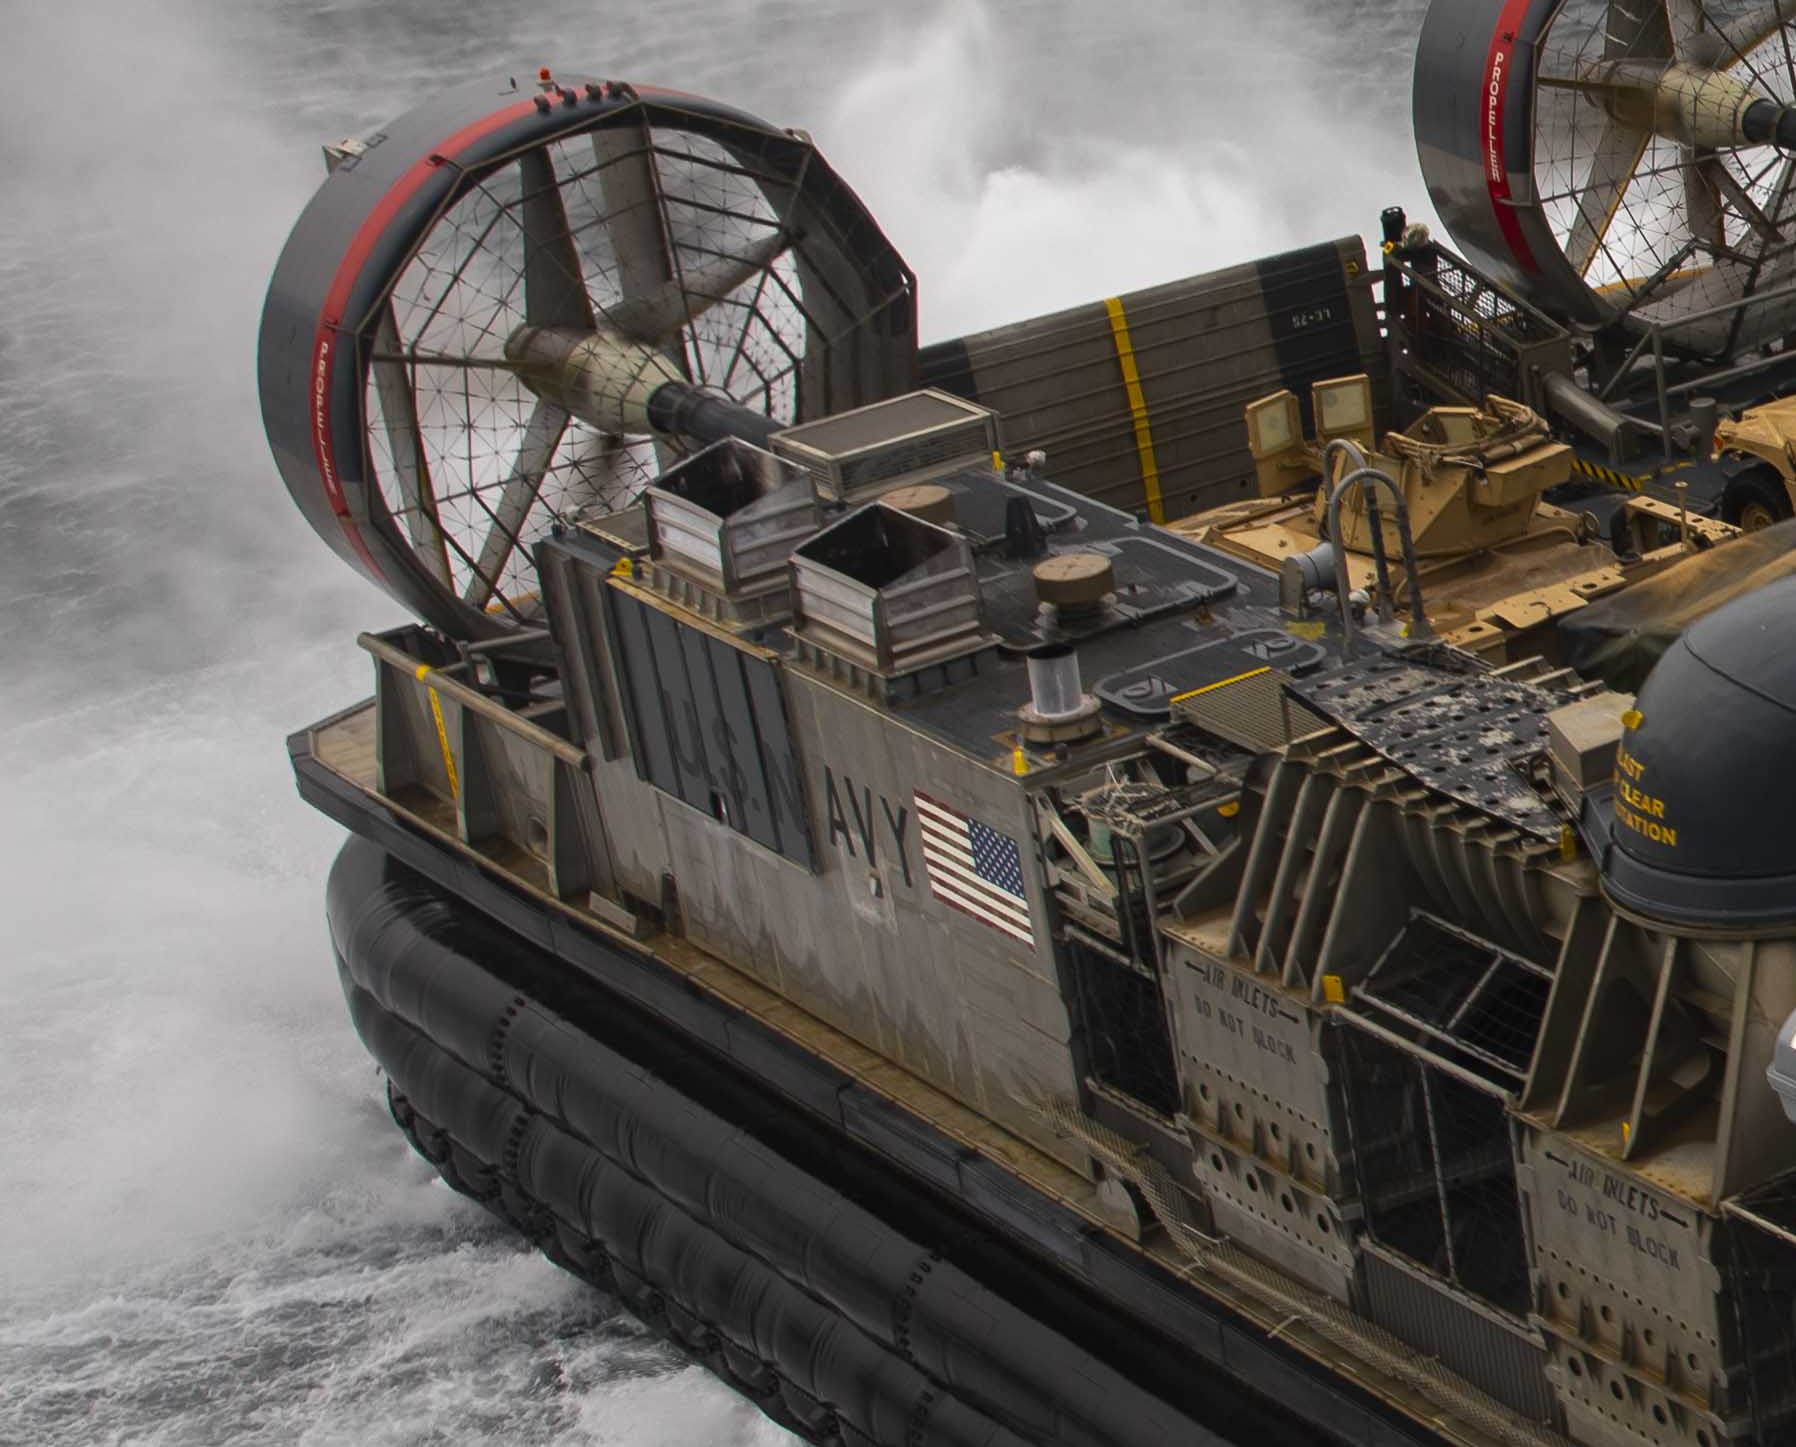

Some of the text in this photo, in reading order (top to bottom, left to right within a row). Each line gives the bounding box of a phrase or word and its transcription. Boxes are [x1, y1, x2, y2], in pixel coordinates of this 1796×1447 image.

[1487, 51, 1505, 183] PROPELLER
[314, 341, 338, 496] PROPELLER
[1619, 778, 1665, 819] CLEAR
[1202, 963, 1279, 1018] AIR INLETS
[1193, 993, 1297, 1065] DO NOT BLOCK
[1568, 1160, 1660, 1221] AIR INLETS
[1557, 1189, 1681, 1271] DO NOT BLOCK
